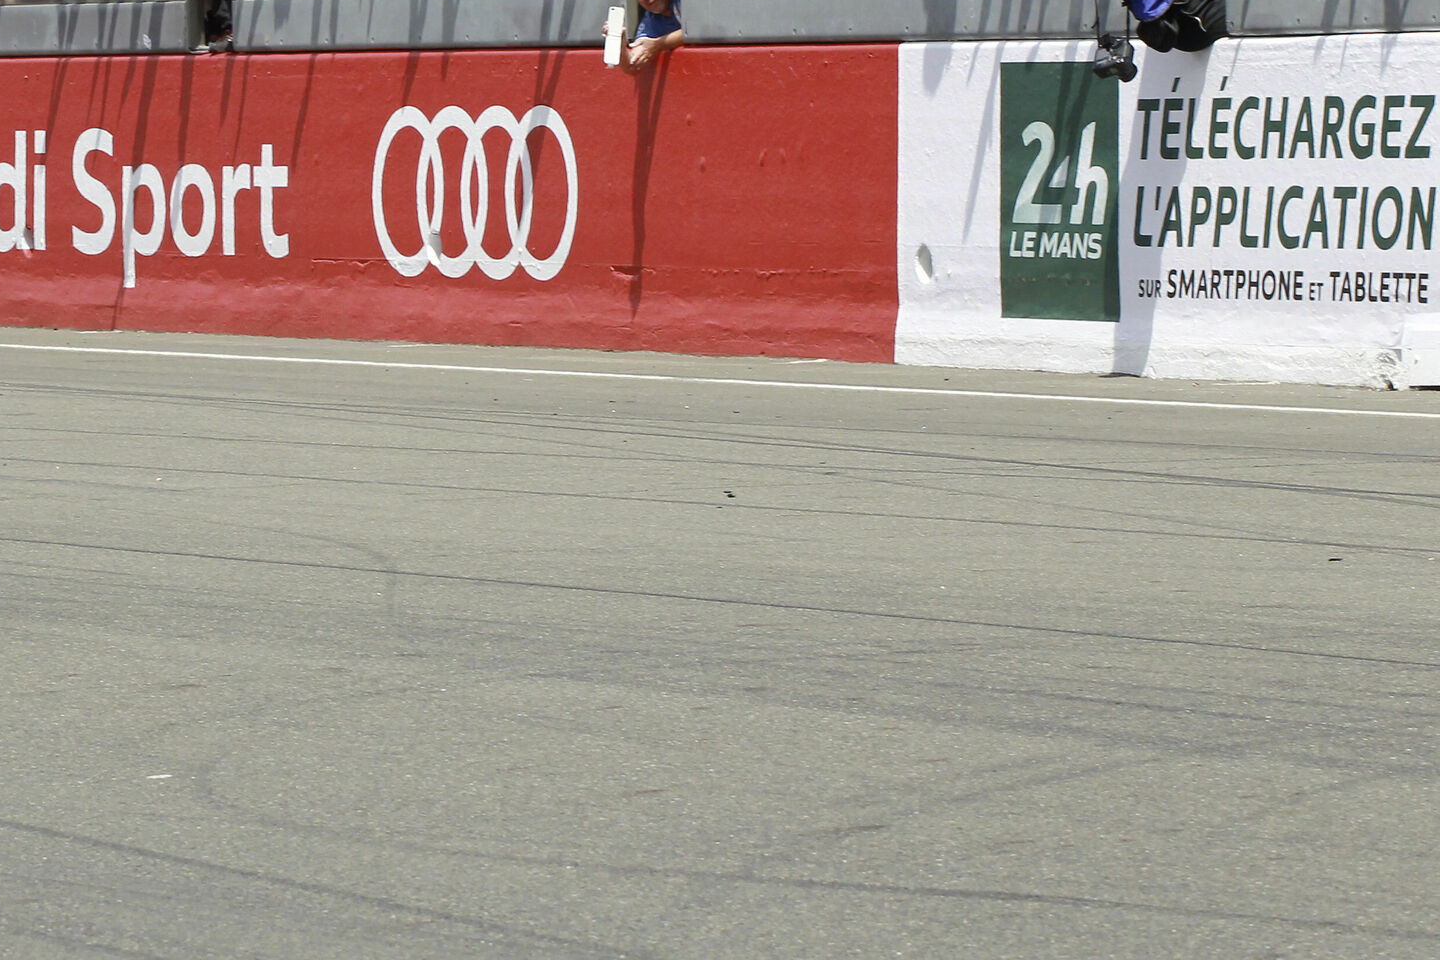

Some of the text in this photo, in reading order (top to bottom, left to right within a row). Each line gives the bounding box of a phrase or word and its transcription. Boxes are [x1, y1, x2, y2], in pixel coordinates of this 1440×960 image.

[1137, 76, 1436, 160] TÉLÉCHARGEZ
[72, 128, 289, 289] Sport
[1012, 121, 1109, 225] 24h
[1009, 231, 1102, 259] LE MANS
[1133, 185, 1437, 250] L'APPLICATION
[1138, 269, 1429, 304] SUR SMARTPHONE ET TABLETTE
